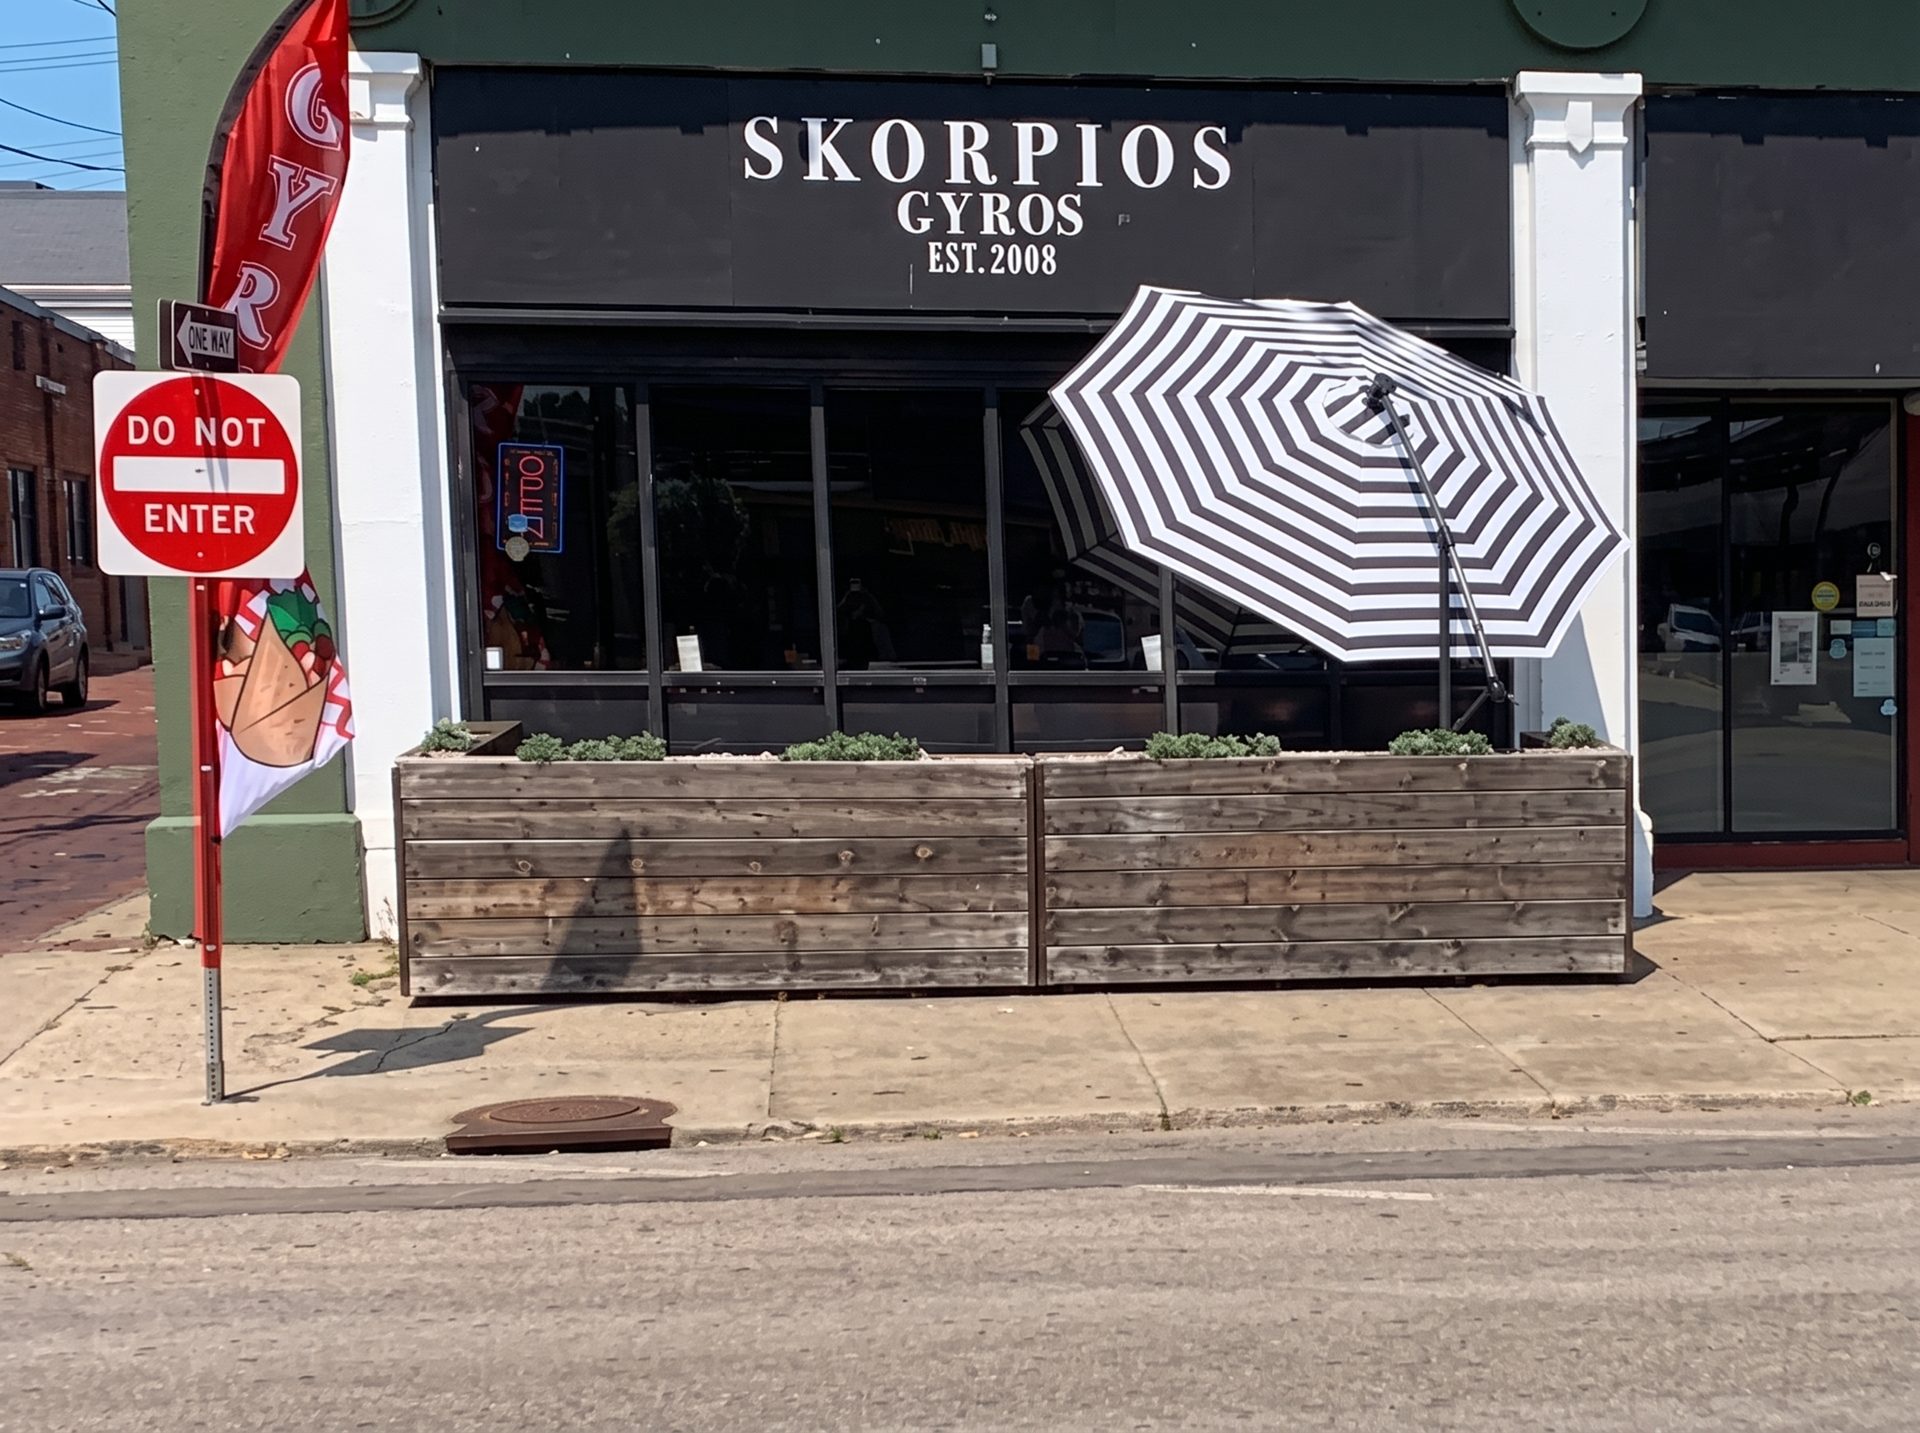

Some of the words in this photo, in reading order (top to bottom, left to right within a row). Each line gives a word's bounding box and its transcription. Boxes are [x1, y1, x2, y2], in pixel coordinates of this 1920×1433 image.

[743, 115, 1232, 190] SKORPIOS
[222, 61, 343, 373] GYR
[896, 190, 1085, 236] GYROS
[188, 325, 208, 352] ONE
[210, 328, 231, 355] WAY
[127, 415, 175, 446] DO
[194, 416, 267, 447] NOT
[144, 503, 256, 535] ENTER
